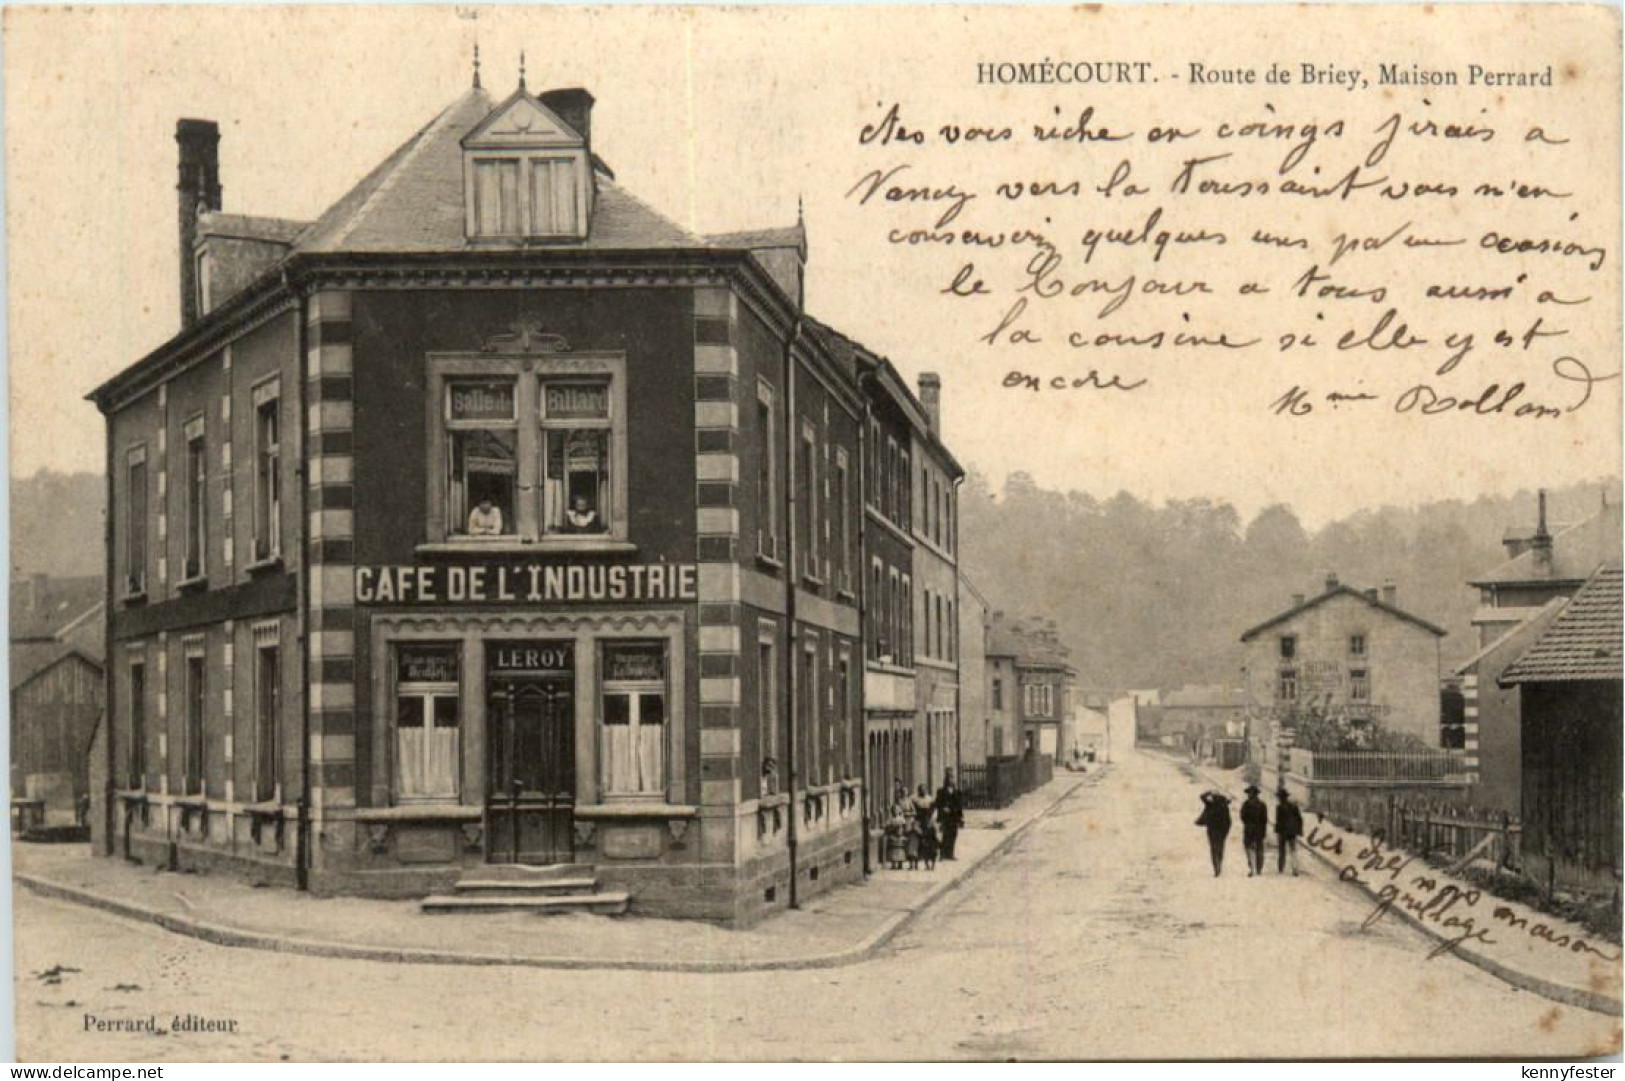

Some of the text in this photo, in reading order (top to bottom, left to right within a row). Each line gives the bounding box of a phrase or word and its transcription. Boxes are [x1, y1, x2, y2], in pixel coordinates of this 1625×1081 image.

[977, 57, 1159, 84] HOMÉCOURT.
[1188, 63, 1256, 84] Route
[1265, 63, 1291, 85] de
[1301, 63, 1369, 91] Briey,
[1378, 63, 1458, 86] Maison
[1467, 65, 1553, 87] Perrard
[995, 180, 1080, 201] vers
[1096, 159, 1150, 198] la
[940, 262, 992, 297] le
[980, 297, 1042, 345] la
[1336, 308, 1429, 350] elle
[1002, 370, 1148, 393] encore
[354, 564, 698, 602] CAFE DE L'INDUSTRIE
[499, 650, 569, 669] LEROY
[171, 1014, 239, 1033] éditeur
